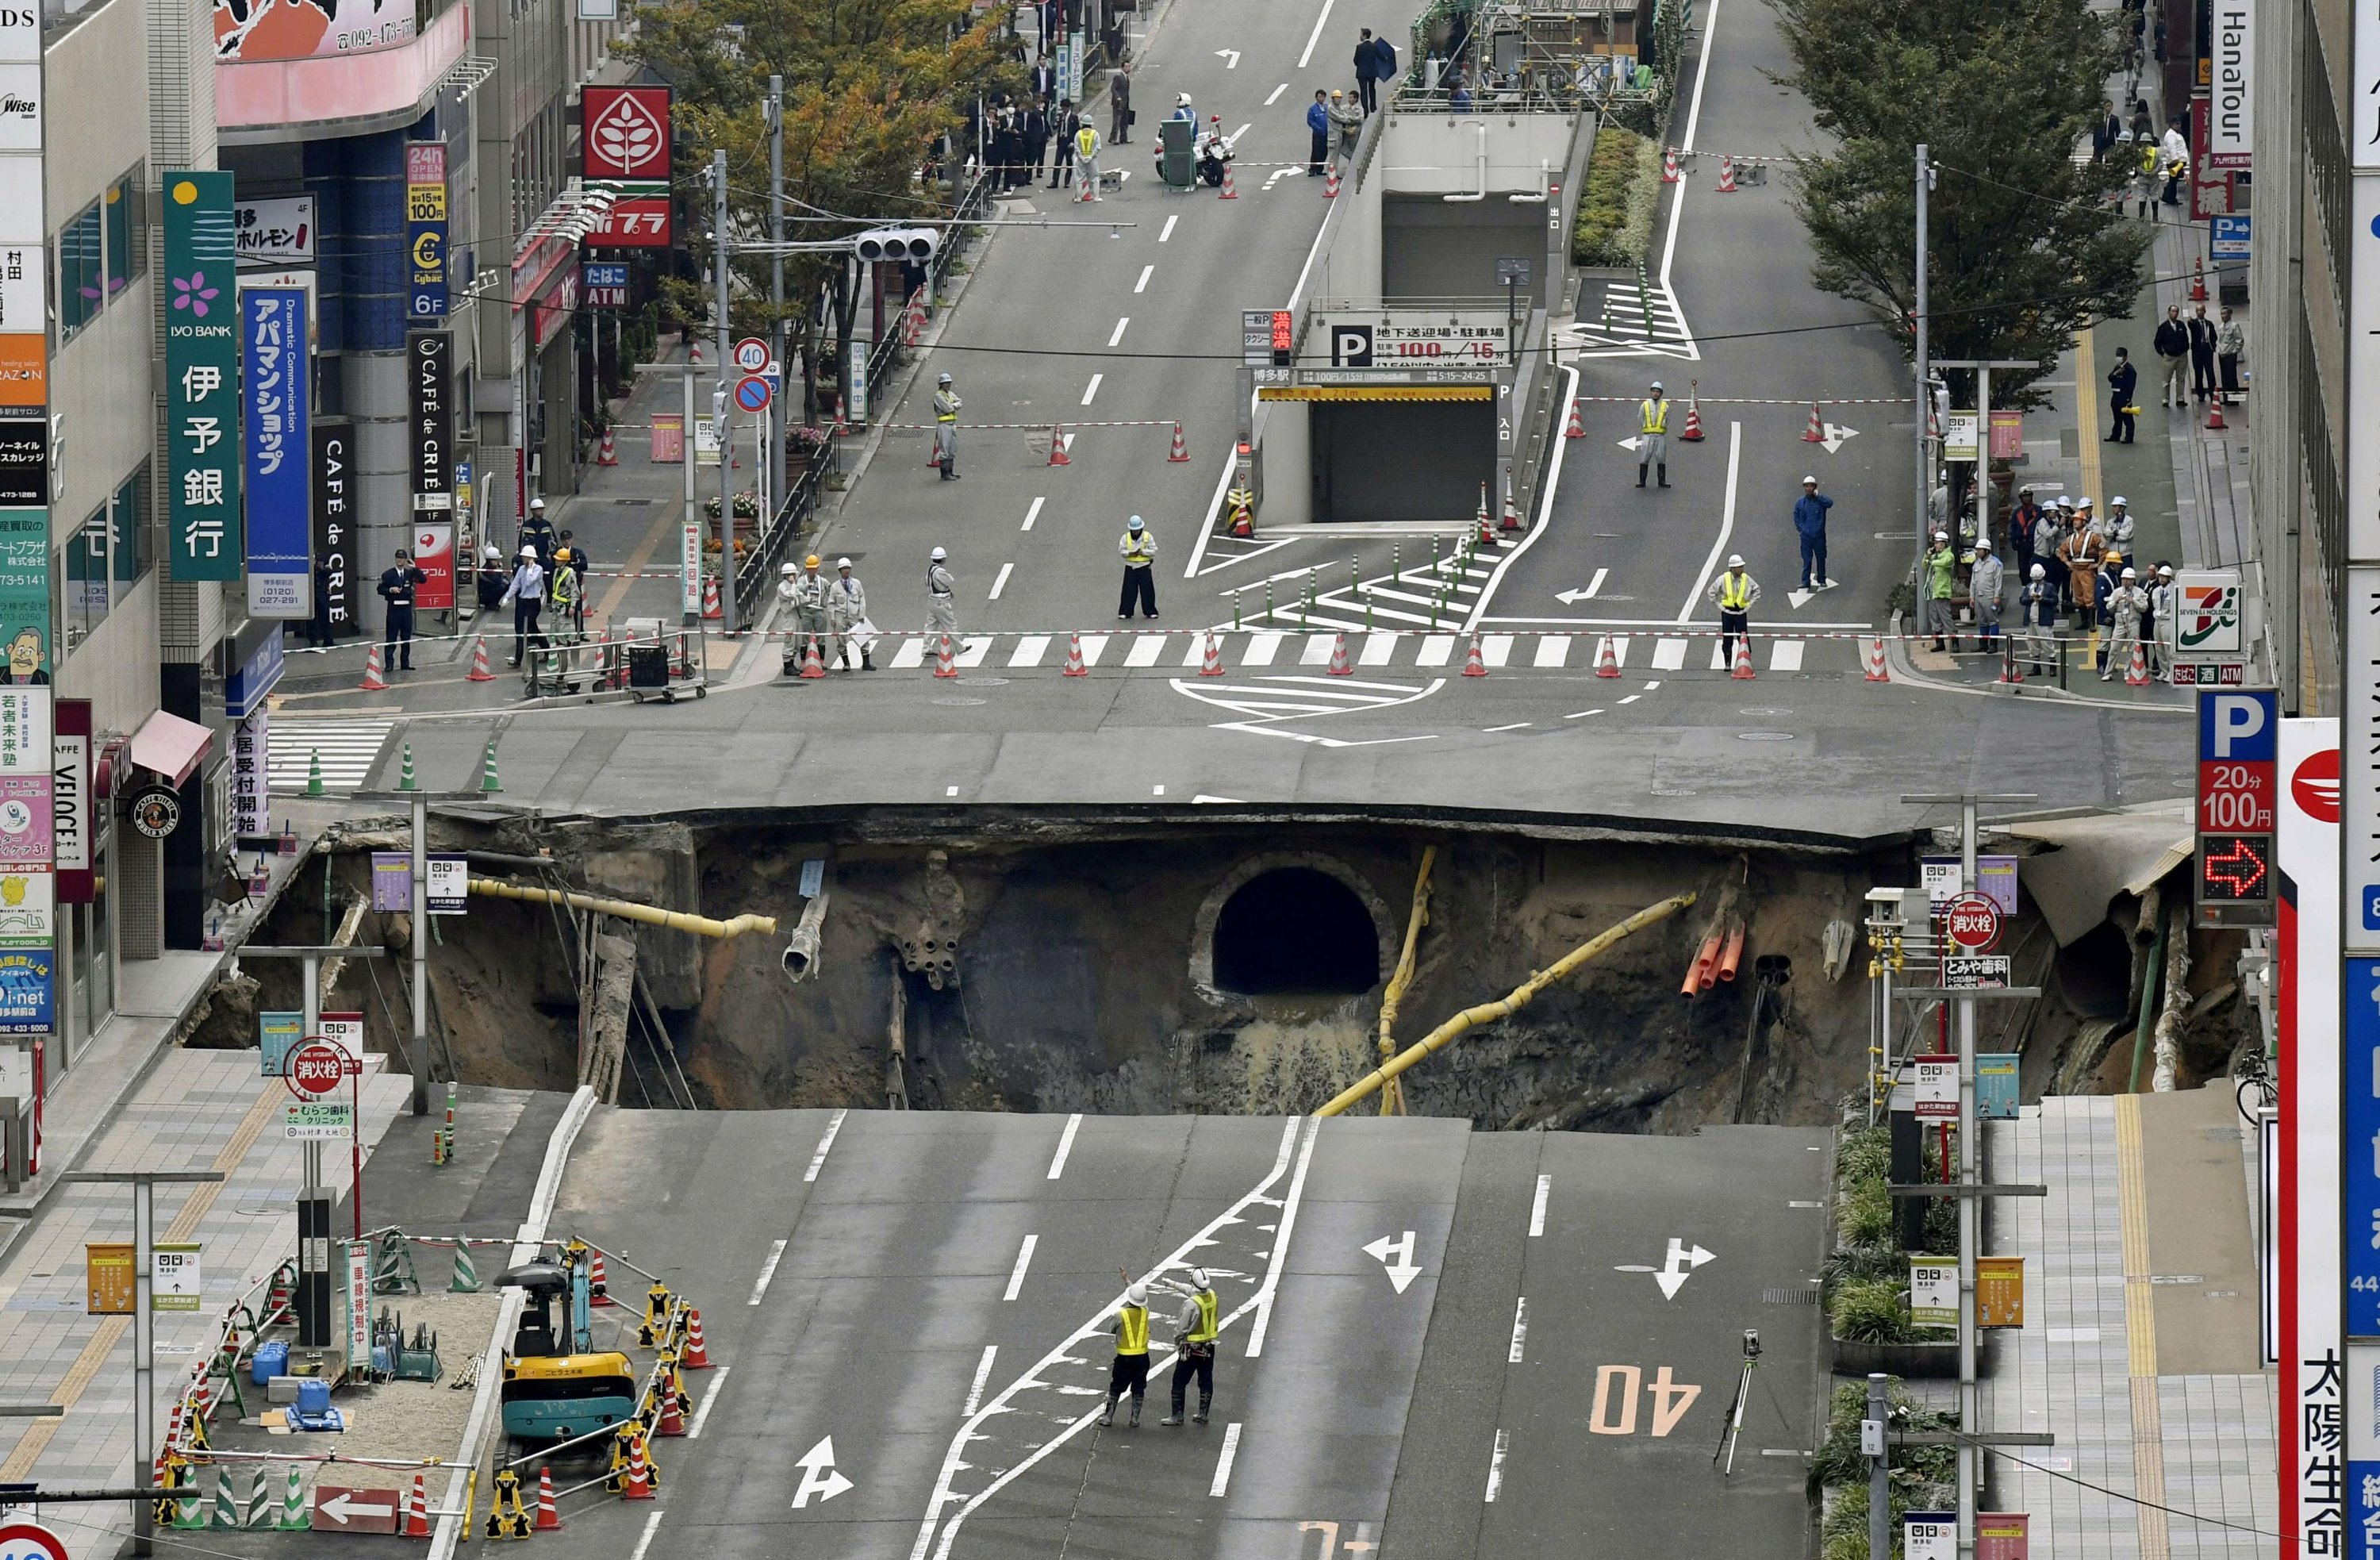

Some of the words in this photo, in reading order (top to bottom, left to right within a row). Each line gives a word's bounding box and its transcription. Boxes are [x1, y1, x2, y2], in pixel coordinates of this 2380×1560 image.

[2221, 11, 2246, 144] HanaTour
[4, 100, 36, 113] Wise
[410, 148, 442, 163] 24h
[411, 204, 443, 219] 100円
[1549, 207, 1560, 229] 出口
[2217, 218, 2234, 238] P
[237, 228, 295, 250] ホルモン
[7, 251, 22, 280] 村田
[587, 267, 624, 284] たばこ
[415, 295, 443, 314] 6F
[588, 288, 625, 305] ATM
[1246, 316, 1269, 325] 一般P
[1273, 313, 1291, 329] 満
[171, 326, 193, 337] IYO
[195, 326, 232, 337] BANK
[1246, 333, 1269, 344] タクシー
[1273, 331, 1291, 348] 満
[1376, 327, 1505, 338] 地下送迎場・駐車場
[742, 349, 762, 365] 40
[1339, 334, 1367, 367] P
[0, 370, 42, 381] AZON
[1253, 369, 1290, 382] 博多駅
[255, 299, 284, 475] アパマンショップ
[423, 359, 440, 413] CAFÉ
[1500, 386, 1510, 399] P
[424, 418, 437, 435] de
[1499, 418, 1511, 441] 入口
[0, 453, 44, 463] スカレッジ
[182, 365, 224, 558] 伊予銀行
[424, 440, 442, 490] CRIÉ
[327, 440, 347, 515] CAFÉ
[427, 512, 439, 521] 1F
[328, 523, 344, 545] de
[7, 557, 46, 567] 株式会社
[328, 553, 349, 624] CRIÉ
[2175, 667, 2195, 682] たばこ
[2201, 667, 2215, 682] 酒
[2221, 667, 2242, 682] ATM
[2, 695, 17, 766] 若者未来塾
[2214, 695, 2266, 759] P
[2213, 765, 2262, 790] 20分
[2203, 792, 2271, 828] 100円
[1952, 914, 1992, 932] 消火栓
[1947, 959, 2007, 975] とみや歯科
[298, 1060, 339, 1079] 消火栓
[301, 1106, 349, 1116] むらつ歯科
[307, 1116, 344, 1125] クリニック
[2350, 1275, 2380, 1293] 44
[1589, 1365, 1702, 1437] 40
